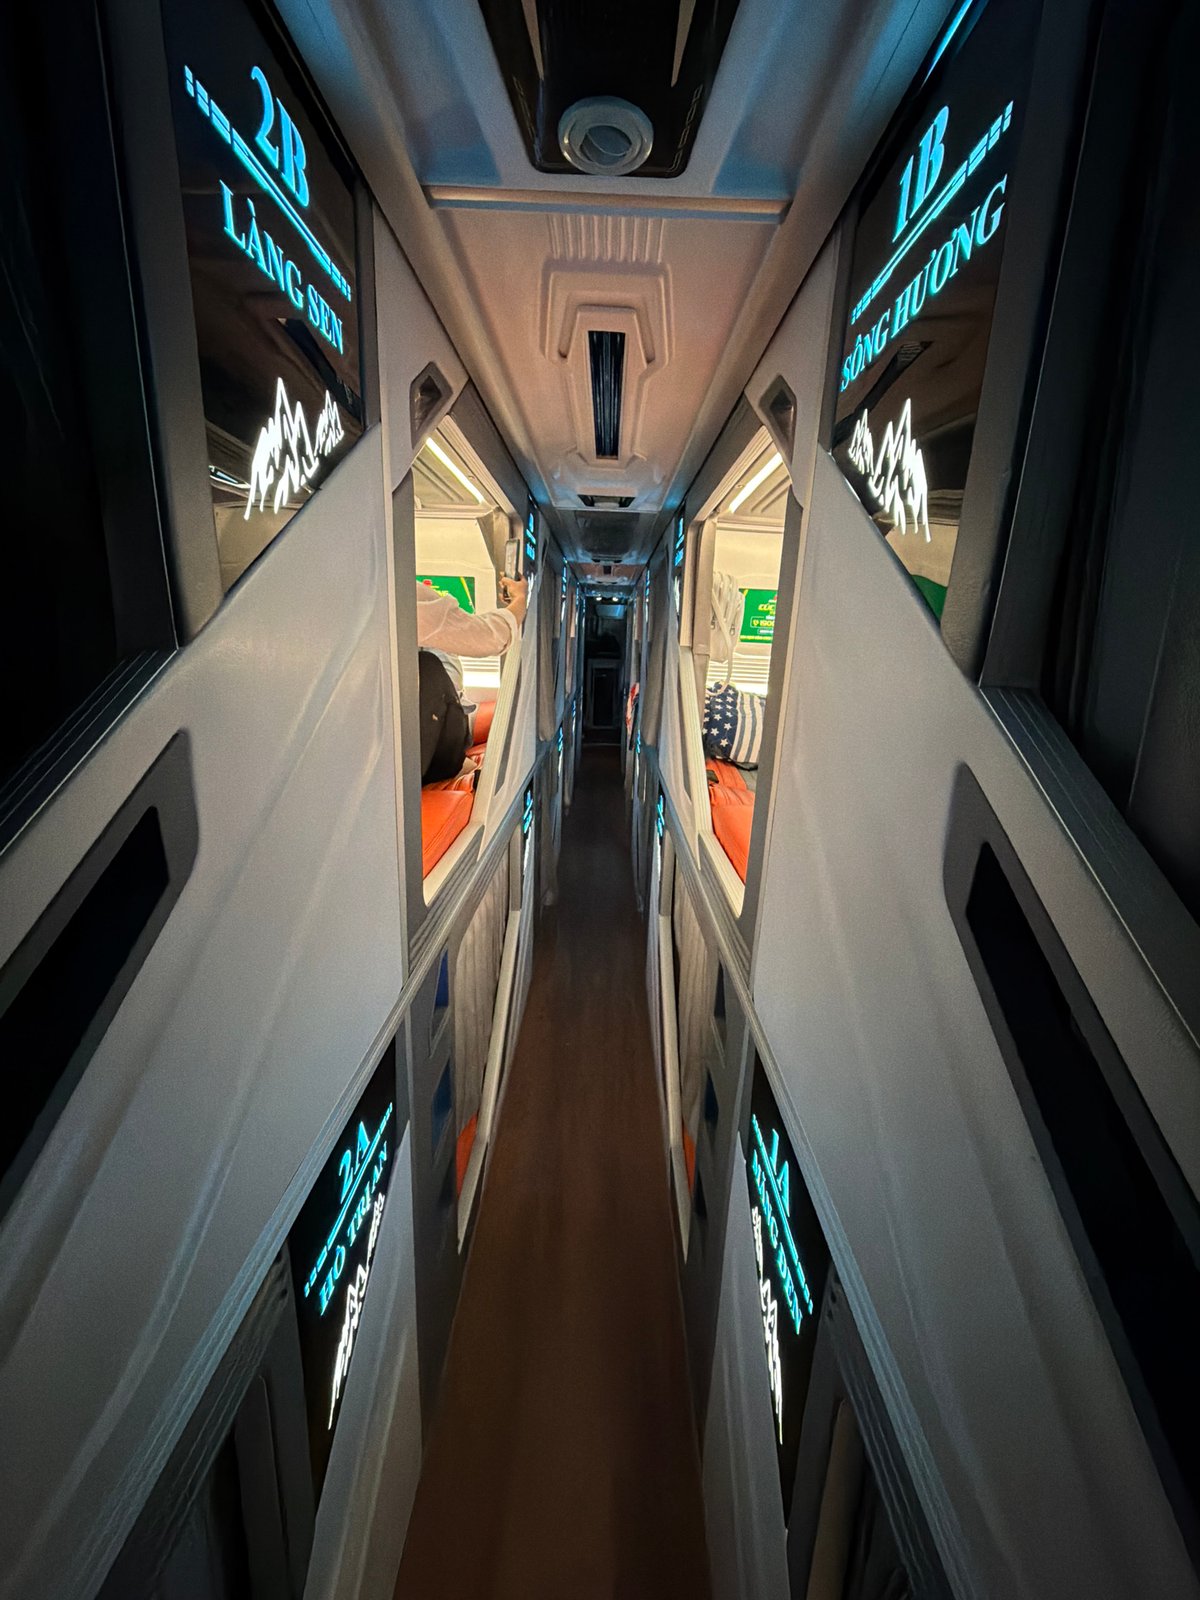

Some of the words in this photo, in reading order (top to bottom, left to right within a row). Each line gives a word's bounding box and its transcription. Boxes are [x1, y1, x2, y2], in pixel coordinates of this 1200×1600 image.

[251, 66, 309, 207] 2B
[892, 105, 949, 243] 1B
[219, 179, 303, 309] LÀNG
[308, 283, 344, 354] SEN
[840, 308, 891, 392] SÔNG
[891, 173, 1008, 338] HƯƠNG
[339, 1121, 370, 1204] 2A
[769, 1128, 790, 1218] 1A
